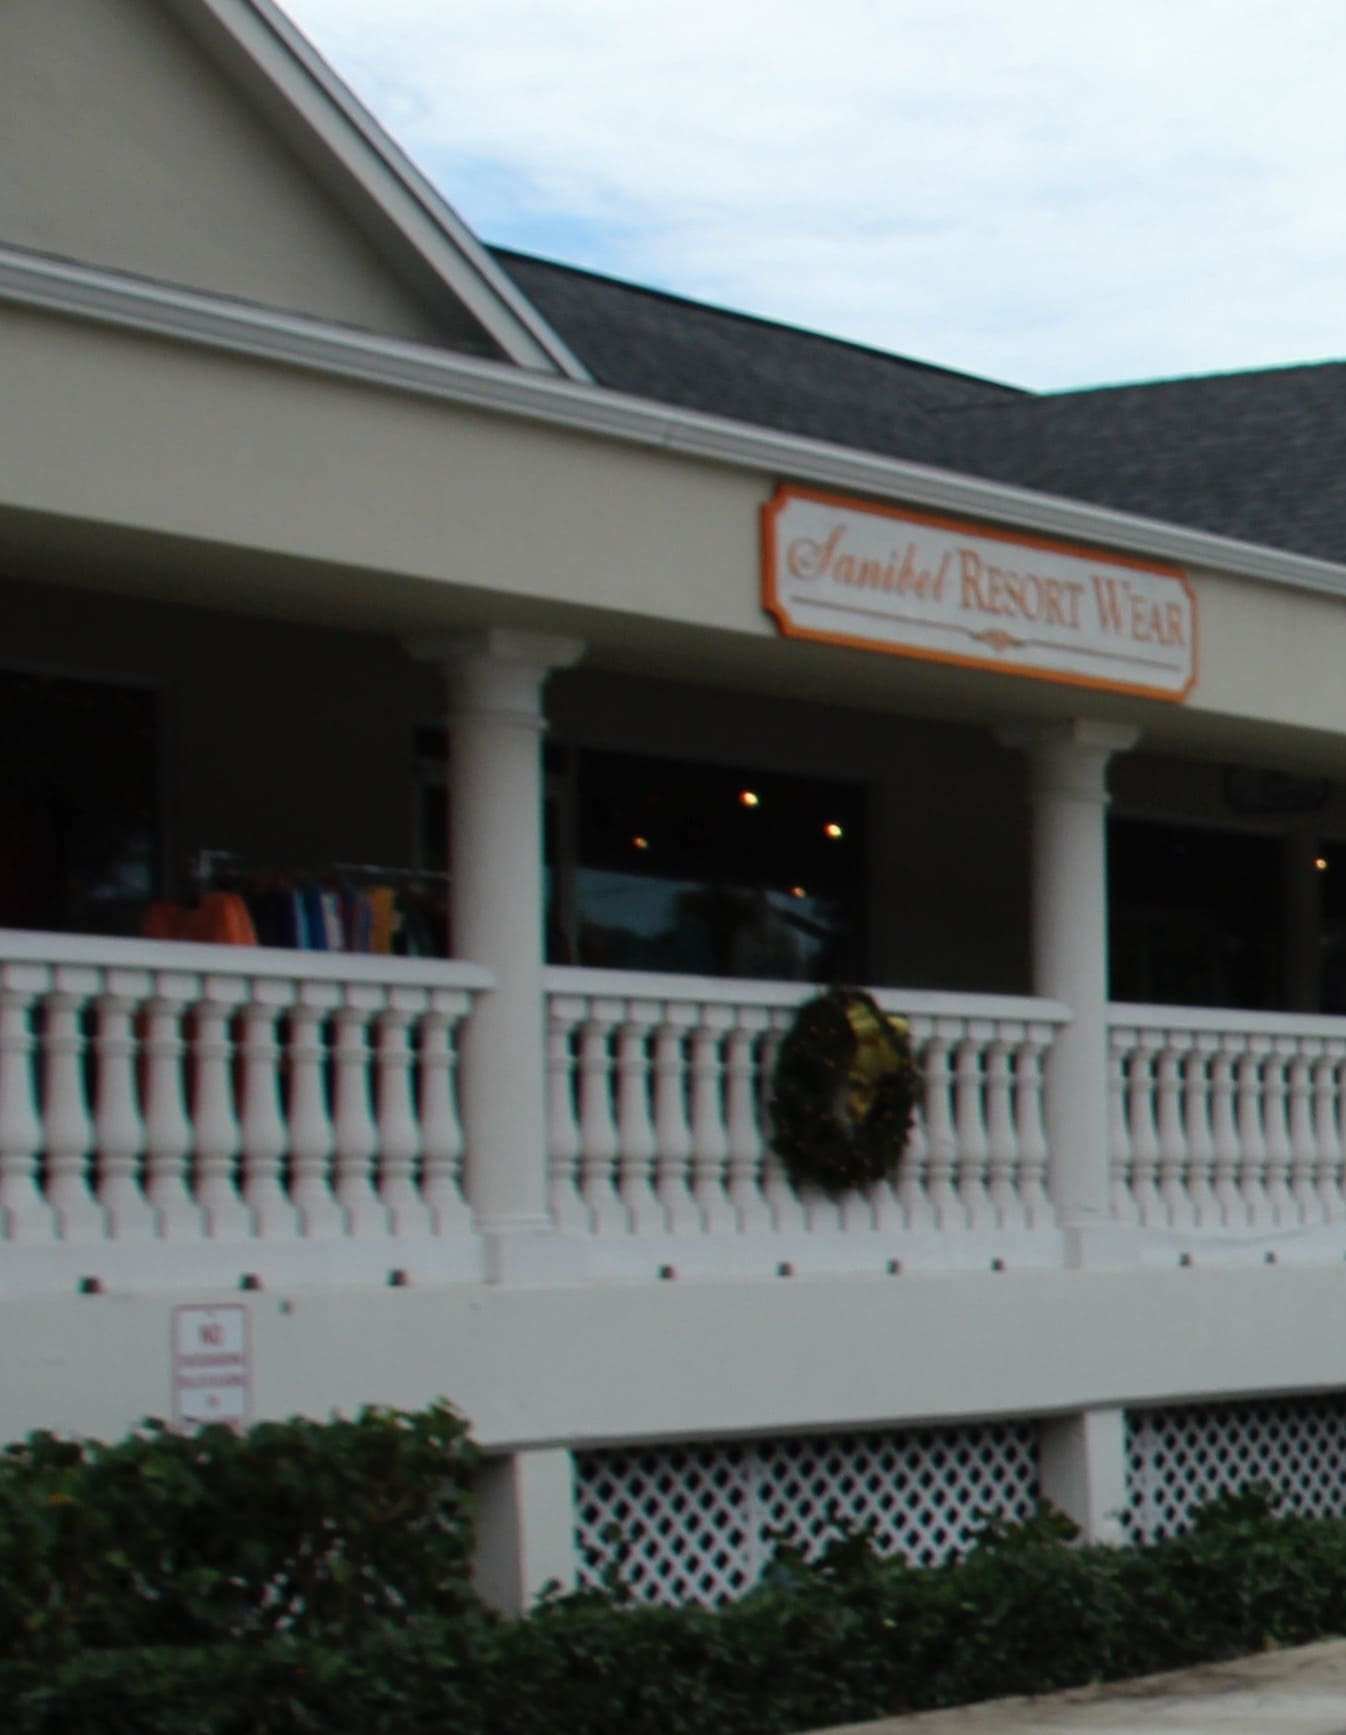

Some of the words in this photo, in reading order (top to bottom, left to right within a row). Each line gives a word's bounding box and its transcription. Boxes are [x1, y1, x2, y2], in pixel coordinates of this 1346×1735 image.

[788, 524, 951, 600] Sanibel
[957, 547, 1084, 630] RESORT
[1092, 574, 1187, 648] WEAR
